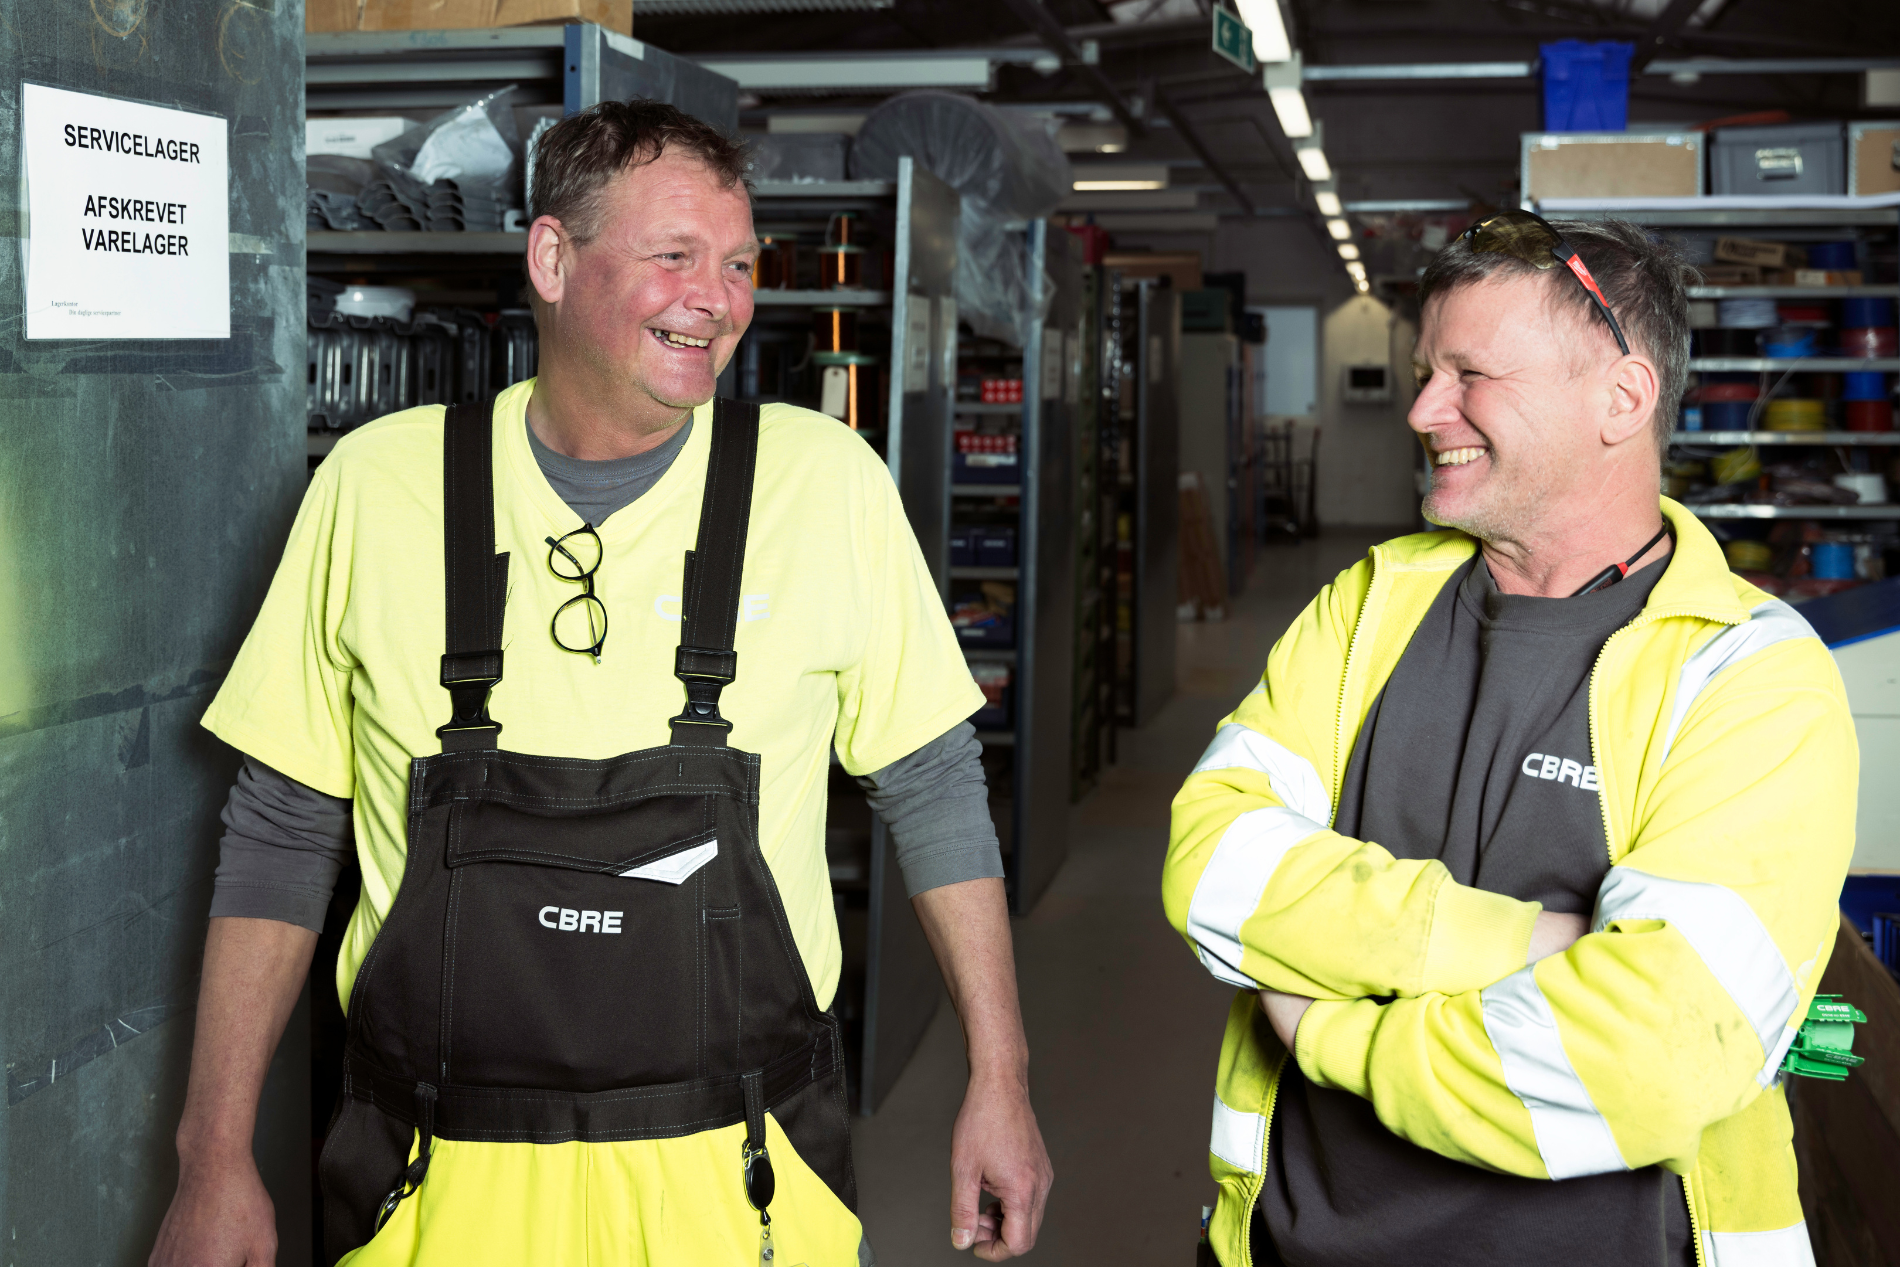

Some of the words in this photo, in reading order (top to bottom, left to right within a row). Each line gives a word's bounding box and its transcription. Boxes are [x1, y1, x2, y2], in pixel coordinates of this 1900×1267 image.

[64, 124, 200, 164] SERVICELAGER
[84, 195, 187, 224] AFSKREVET
[82, 228, 189, 256] VARELAGER
[78, 309, 92, 317] daglige
[654, 594, 770, 622] CE
[1522, 752, 1599, 792] CBRE
[538, 905, 624, 934] CBRE
[1816, 1004, 1850, 1013] CBRE
